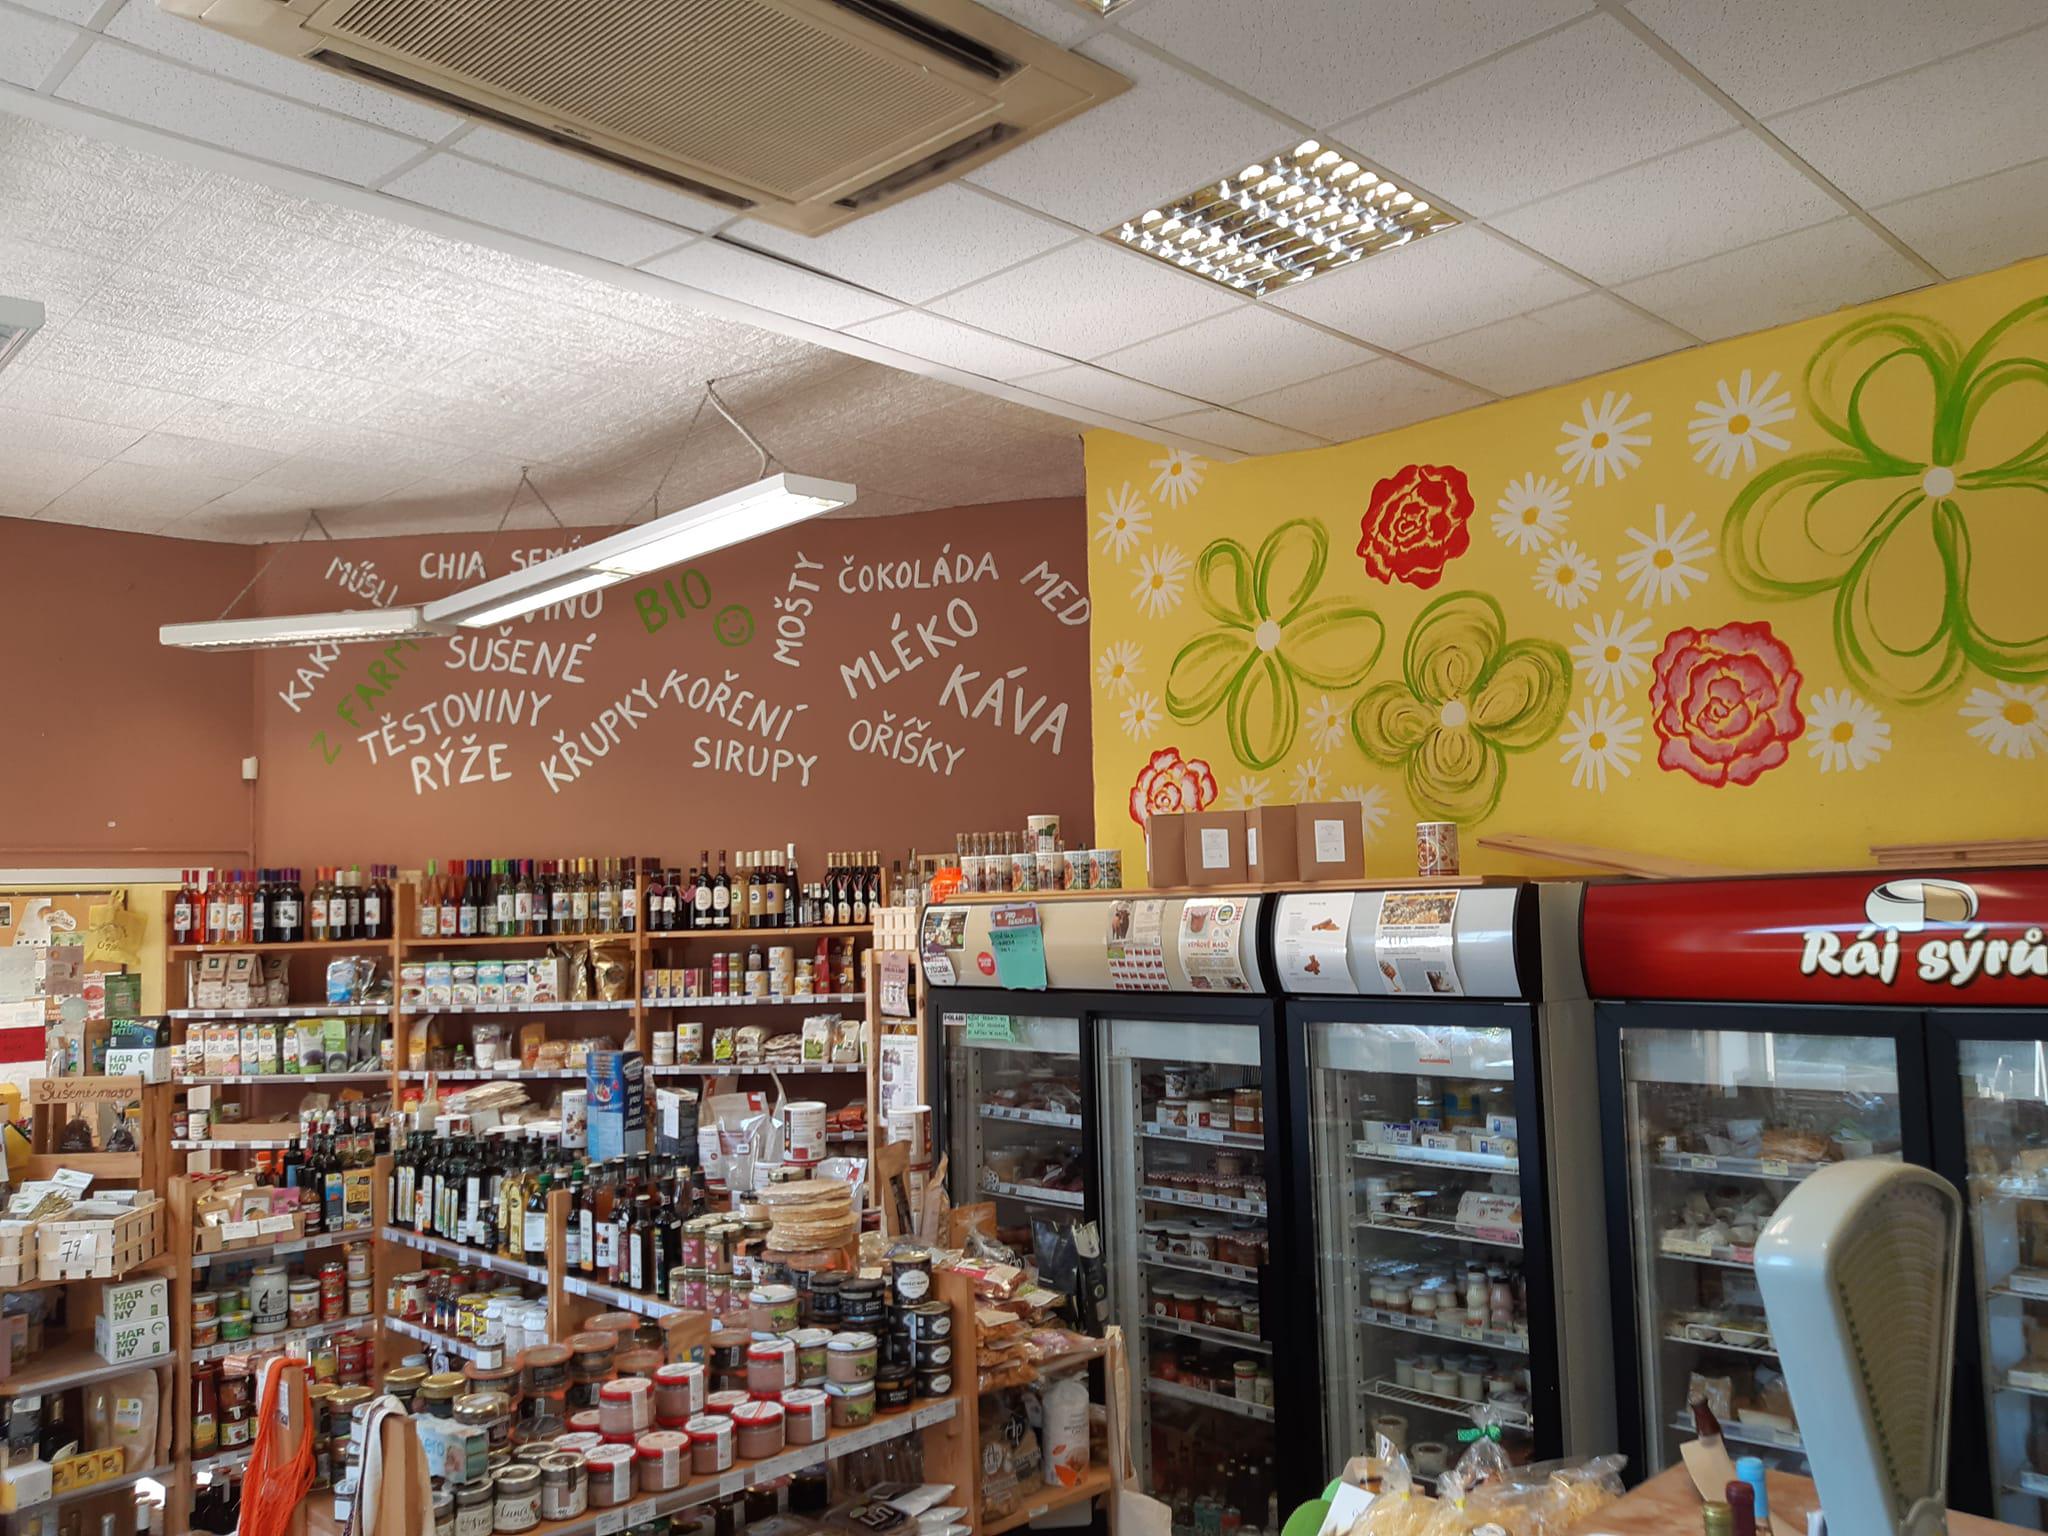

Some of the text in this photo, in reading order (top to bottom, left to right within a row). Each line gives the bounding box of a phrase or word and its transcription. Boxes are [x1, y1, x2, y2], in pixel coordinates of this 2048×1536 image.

[419, 552, 487, 580] CHIA
[838, 543, 999, 594] ČOKOLÁDA
[1020, 560, 1091, 626] MED
[633, 568, 712, 634] BIO
[773, 551, 824, 667] MOŠTY
[444, 626, 597, 683] SUŠENÉ
[839, 597, 979, 699] MLÉKO
[358, 688, 552, 765] TĚSTOVINY
[660, 669, 809, 742] KOŘENÍ
[939, 664, 1069, 755] KÁVA
[308, 728, 343, 767] Z
[540, 678, 659, 794] KŘUPKY
[692, 736, 818, 787] SIRUPY
[848, 710, 966, 776] OŘÍŠKY
[411, 733, 513, 795] RÝŽE
[1800, 922, 2048, 987] Ráj sýrů
[109, 1054, 133, 1063] HAR
[109, 1063, 127, 1072] MO
[113, 1289, 144, 1302] HAR
[113, 1300, 136, 1311] MO
[113, 1310, 133, 1320] NY
[116, 1328, 145, 1340] HAR
[116, 1338, 138, 1349] MO
[116, 1347, 134, 1358] NY
